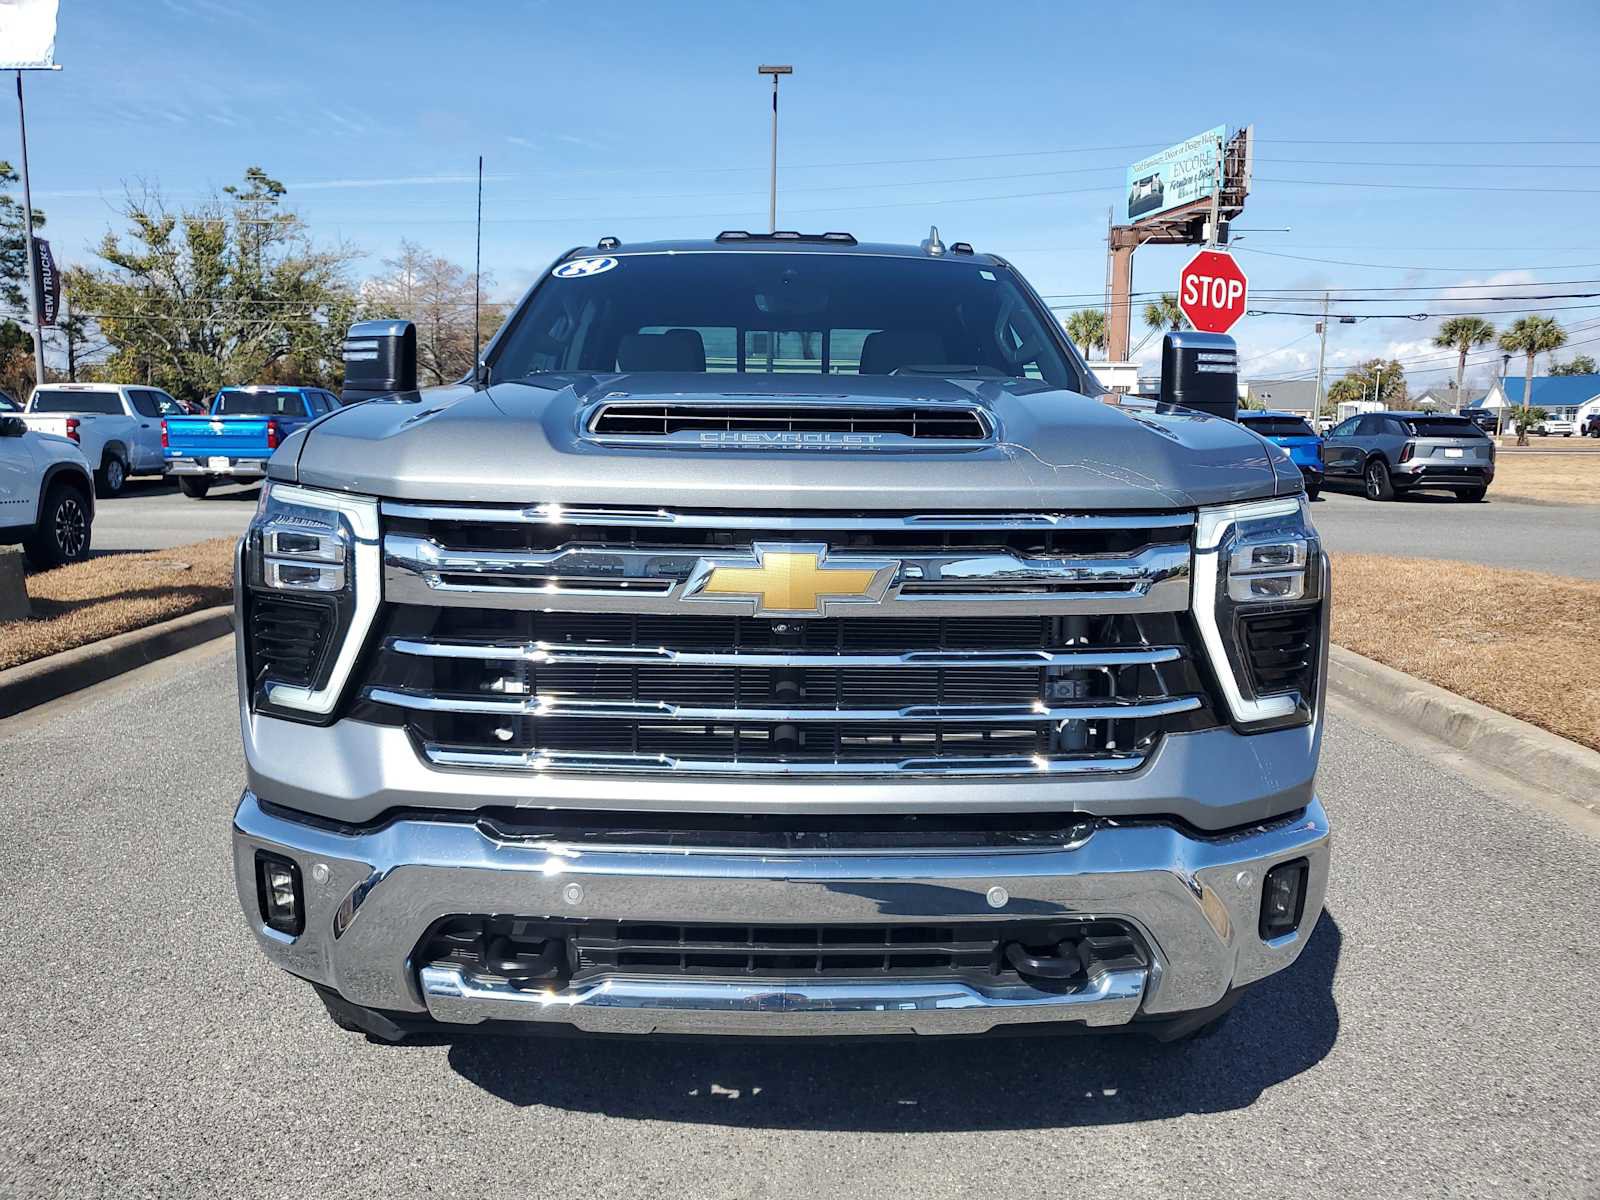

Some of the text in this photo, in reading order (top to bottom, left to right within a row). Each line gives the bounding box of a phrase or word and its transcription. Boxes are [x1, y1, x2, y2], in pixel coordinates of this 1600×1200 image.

[1174, 151, 1211, 177] ENCORE
[40, 244, 54, 321] NEW TRUCKS
[1184, 274, 1243, 309] STOP
[700, 432, 882, 444] CHEVROLET
